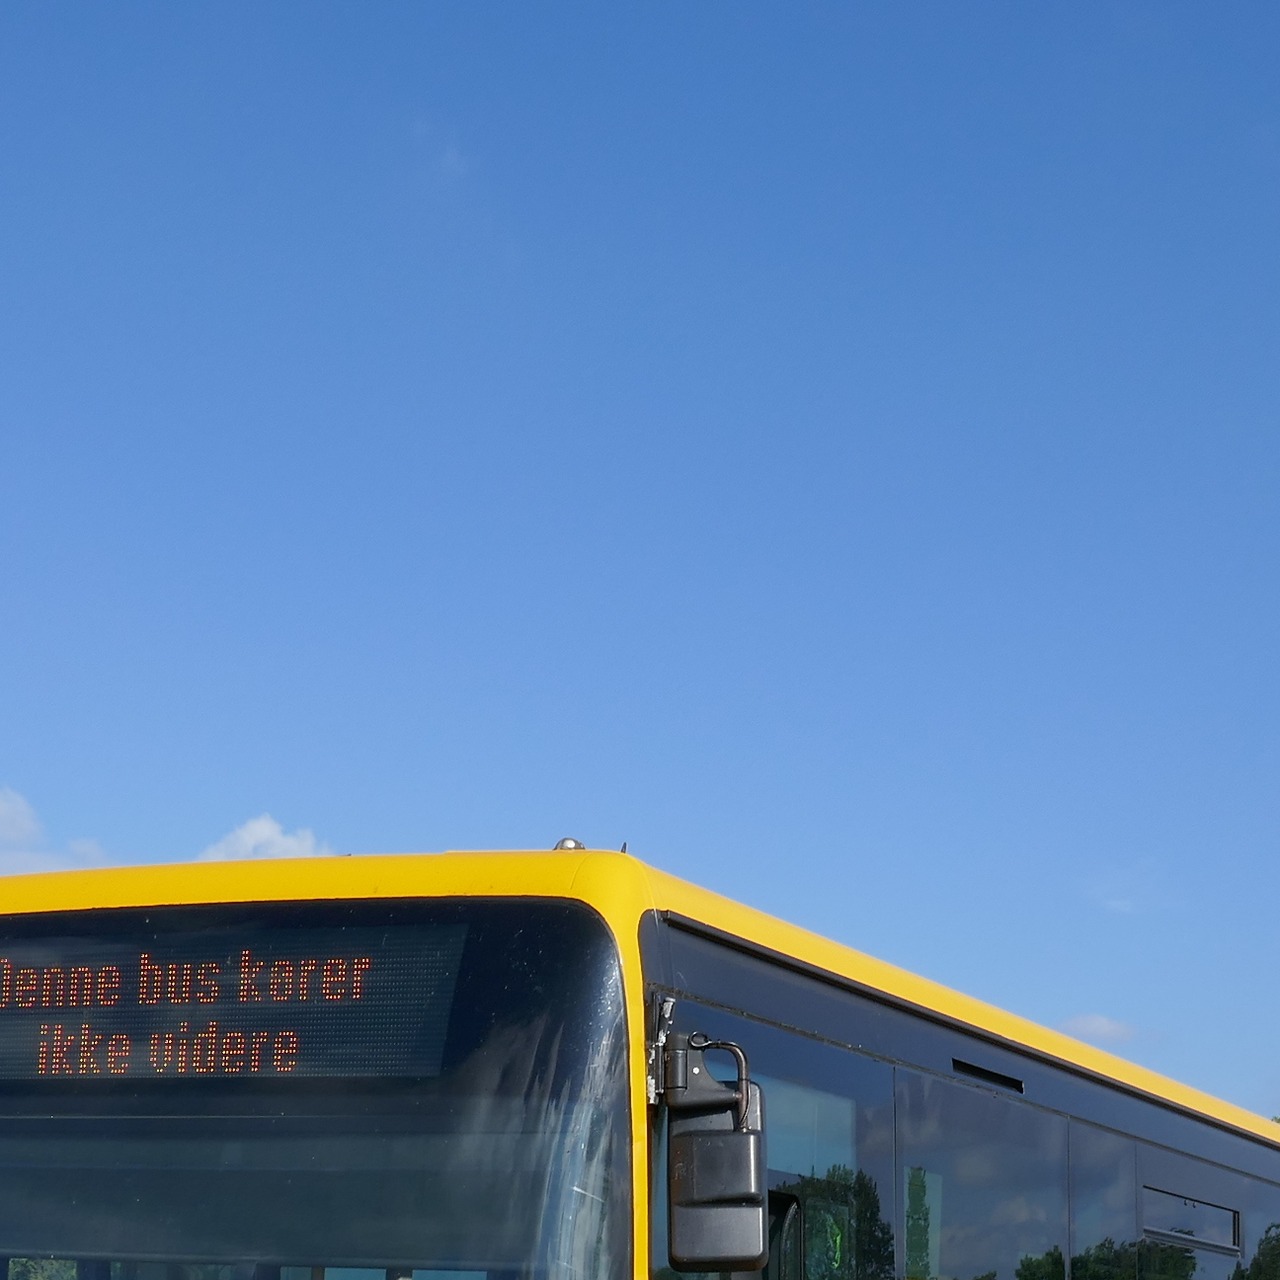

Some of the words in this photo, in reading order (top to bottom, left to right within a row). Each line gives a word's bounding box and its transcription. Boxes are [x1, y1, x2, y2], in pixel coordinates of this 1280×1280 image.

[138, 953, 219, 1005] bus
[38, 1024, 132, 1075] ikke
[150, 1021, 299, 1073] videre
